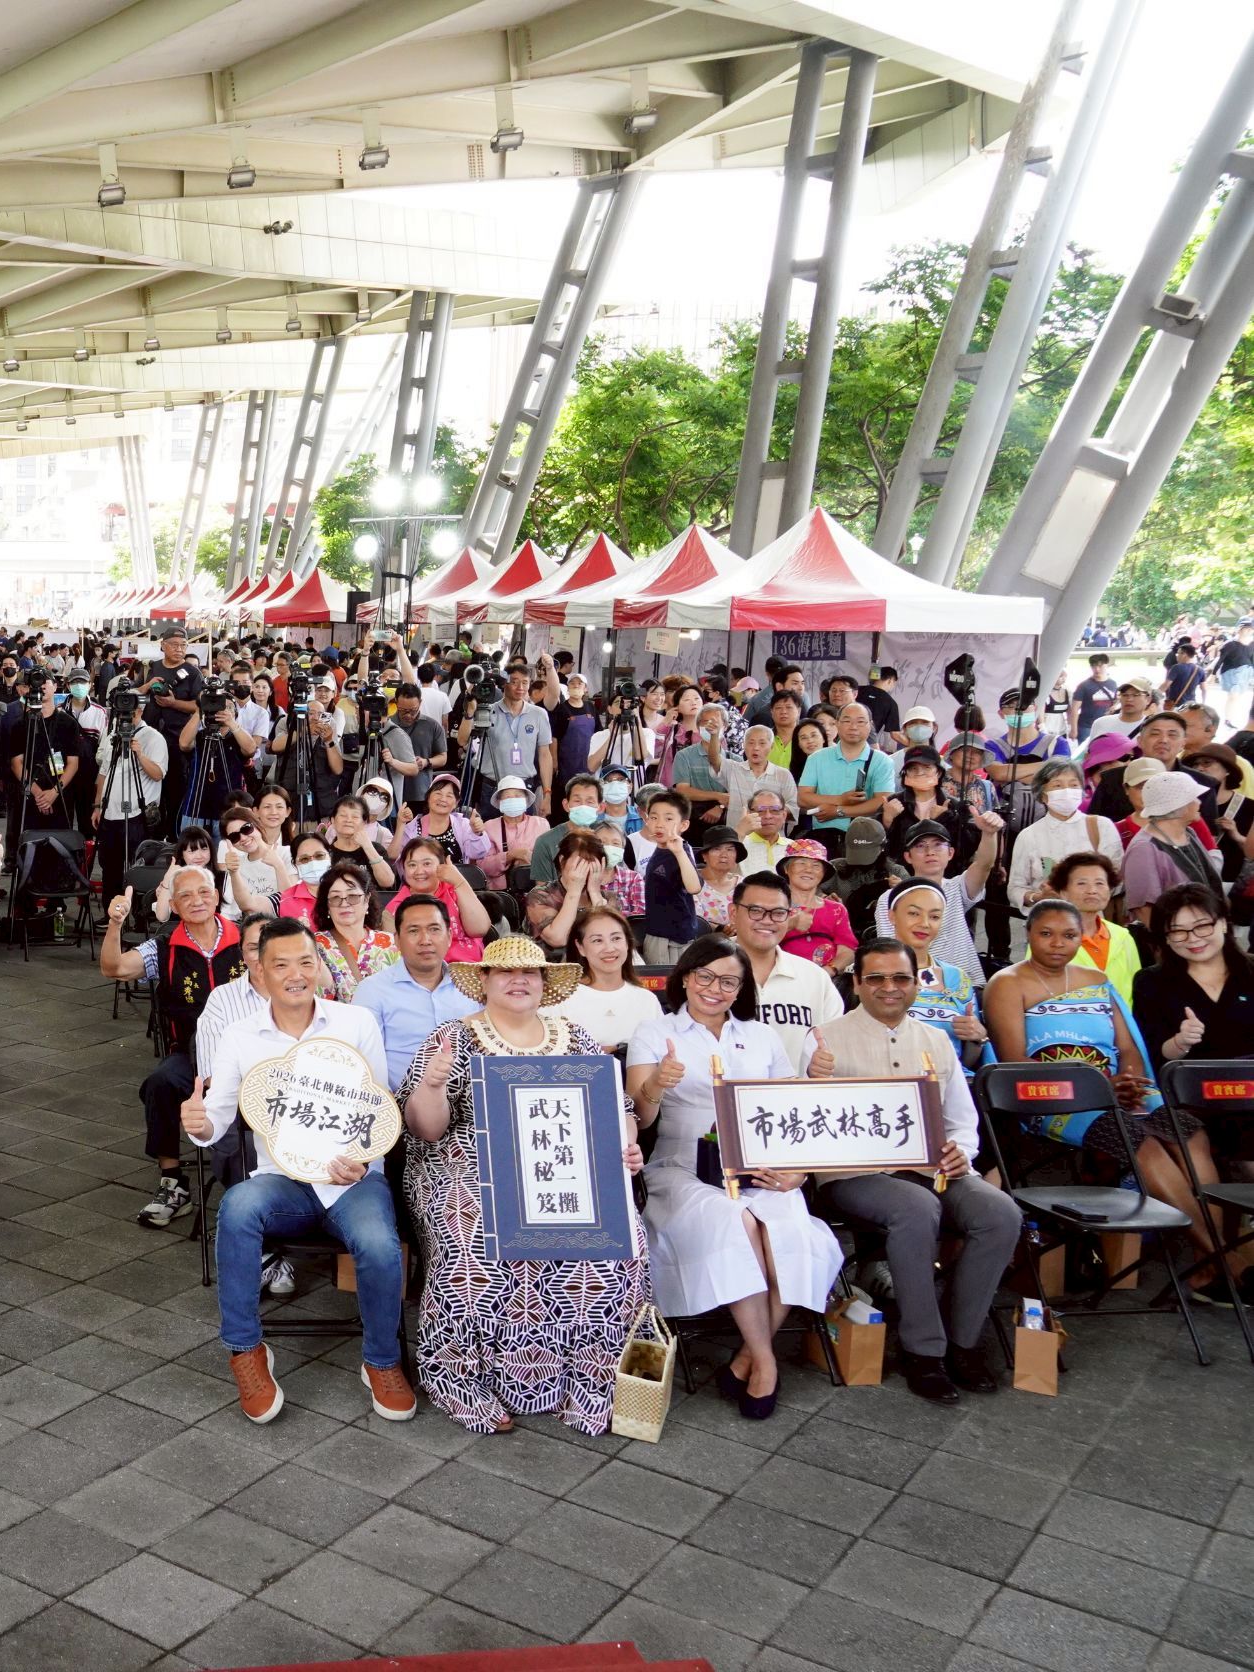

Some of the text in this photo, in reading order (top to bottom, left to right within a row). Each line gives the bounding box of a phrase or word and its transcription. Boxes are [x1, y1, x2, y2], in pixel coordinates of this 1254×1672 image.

[268, 1067, 297, 1084] 2026
[265, 1089, 377, 1149] 市場江湖
[746, 1102, 915, 1150] 市場武林高手
[527, 1097, 558, 1214] 武林秘笈
[549, 1097, 581, 1214] 天下第一攤
